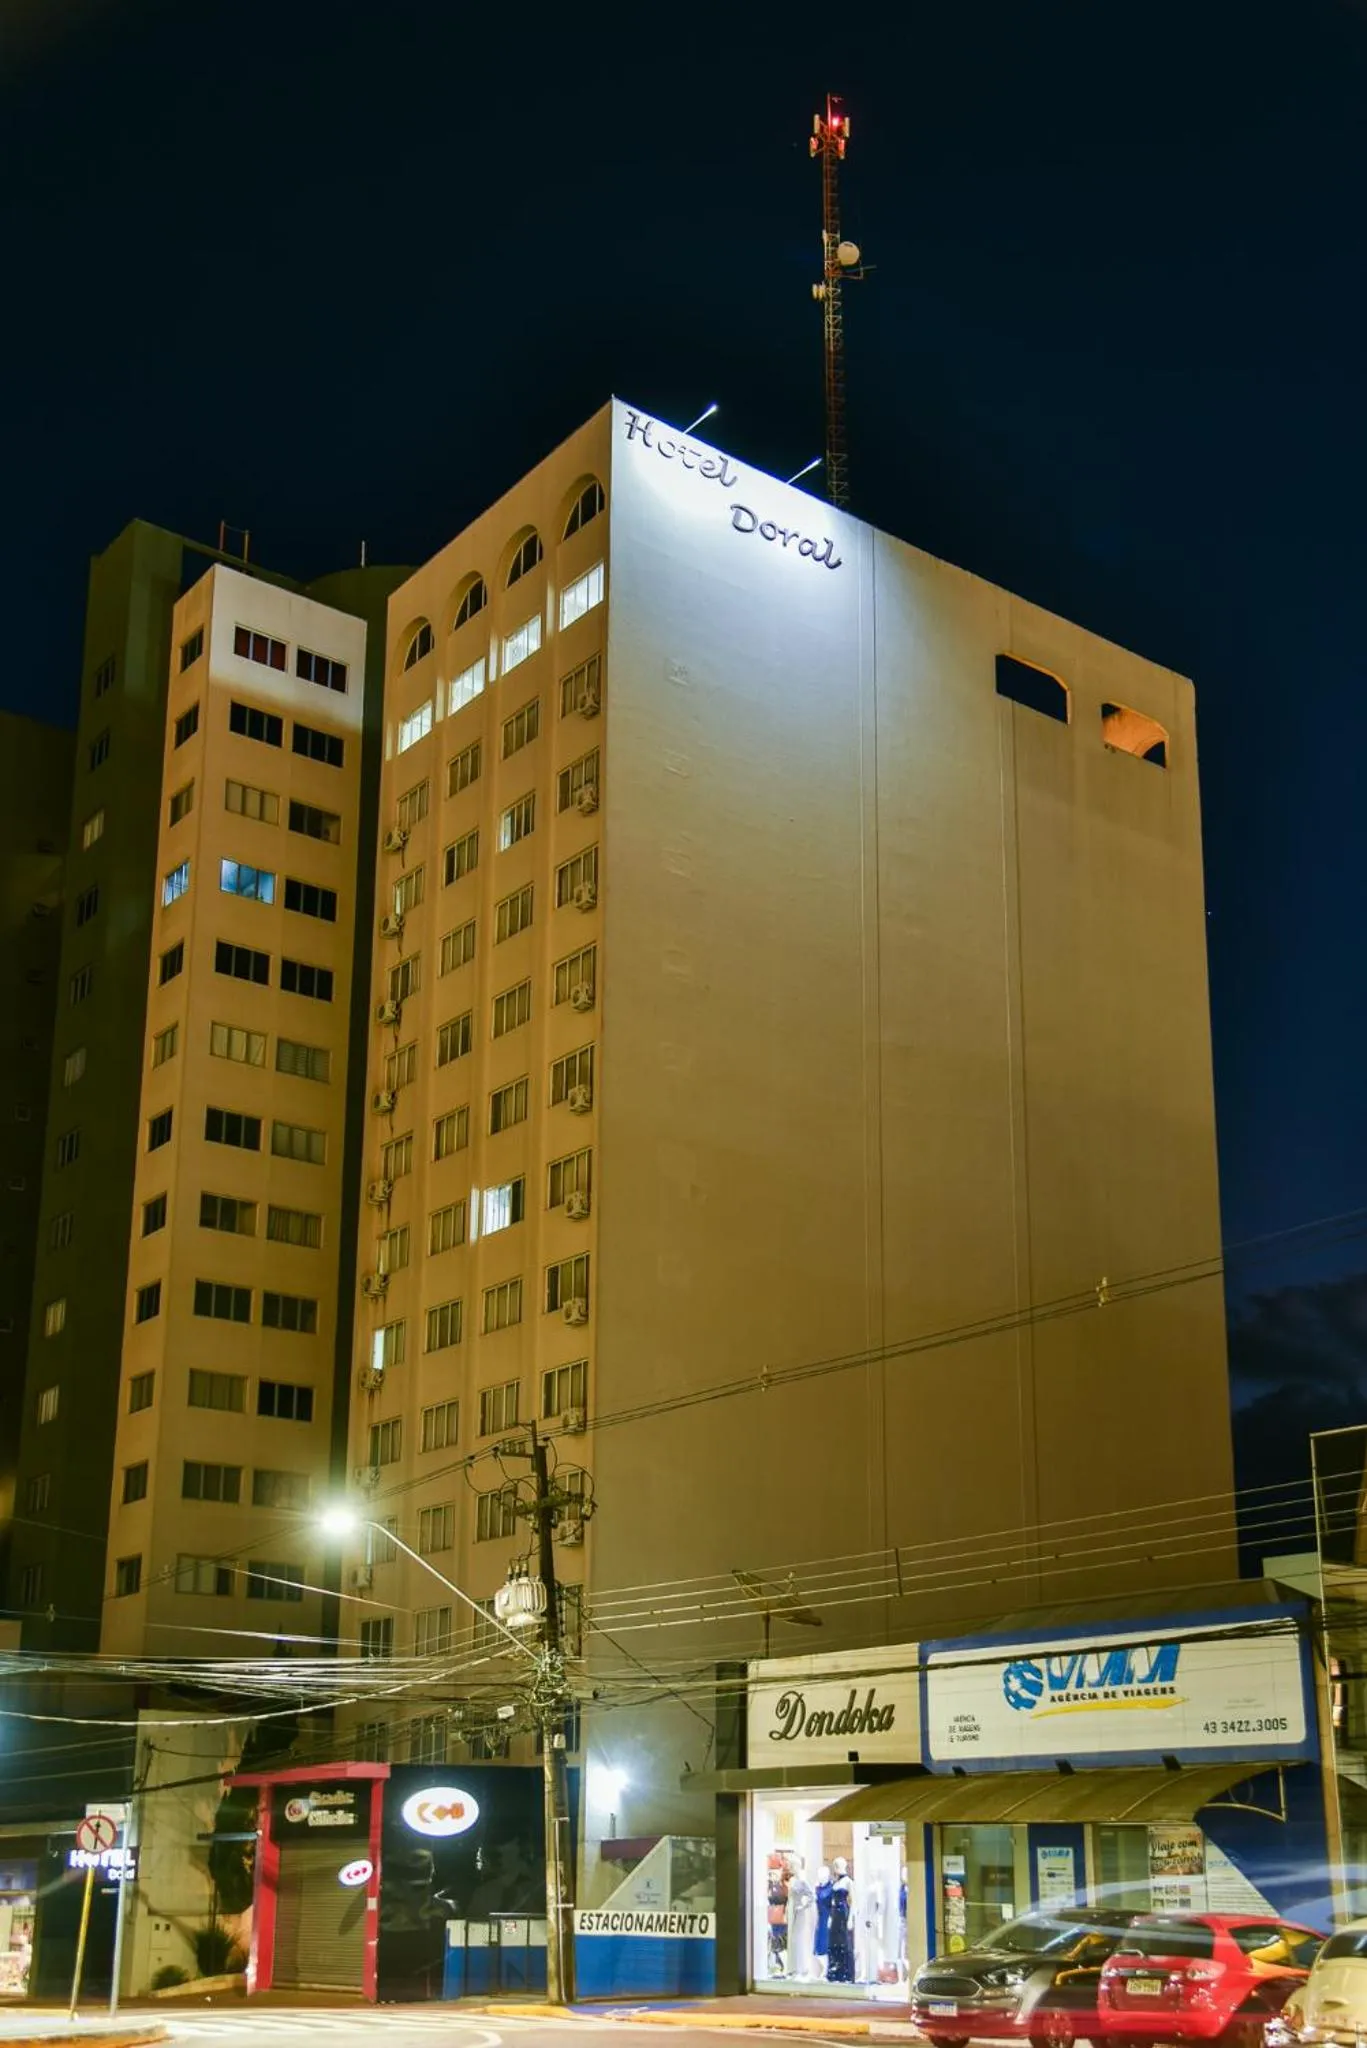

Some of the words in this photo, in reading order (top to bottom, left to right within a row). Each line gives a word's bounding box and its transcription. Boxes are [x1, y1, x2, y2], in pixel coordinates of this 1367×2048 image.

[625, 410, 738, 488] Hotel
[729, 503, 842, 570] Doral
[1122, 1686, 1176, 1698] VIAGENS
[769, 1688, 895, 1741] Dondoka
[1203, 1721, 1217, 1734] 43
[1221, 1717, 1288, 1733] 3422.3005
[579, 1912, 709, 1934] ESTACIONAMENTO
